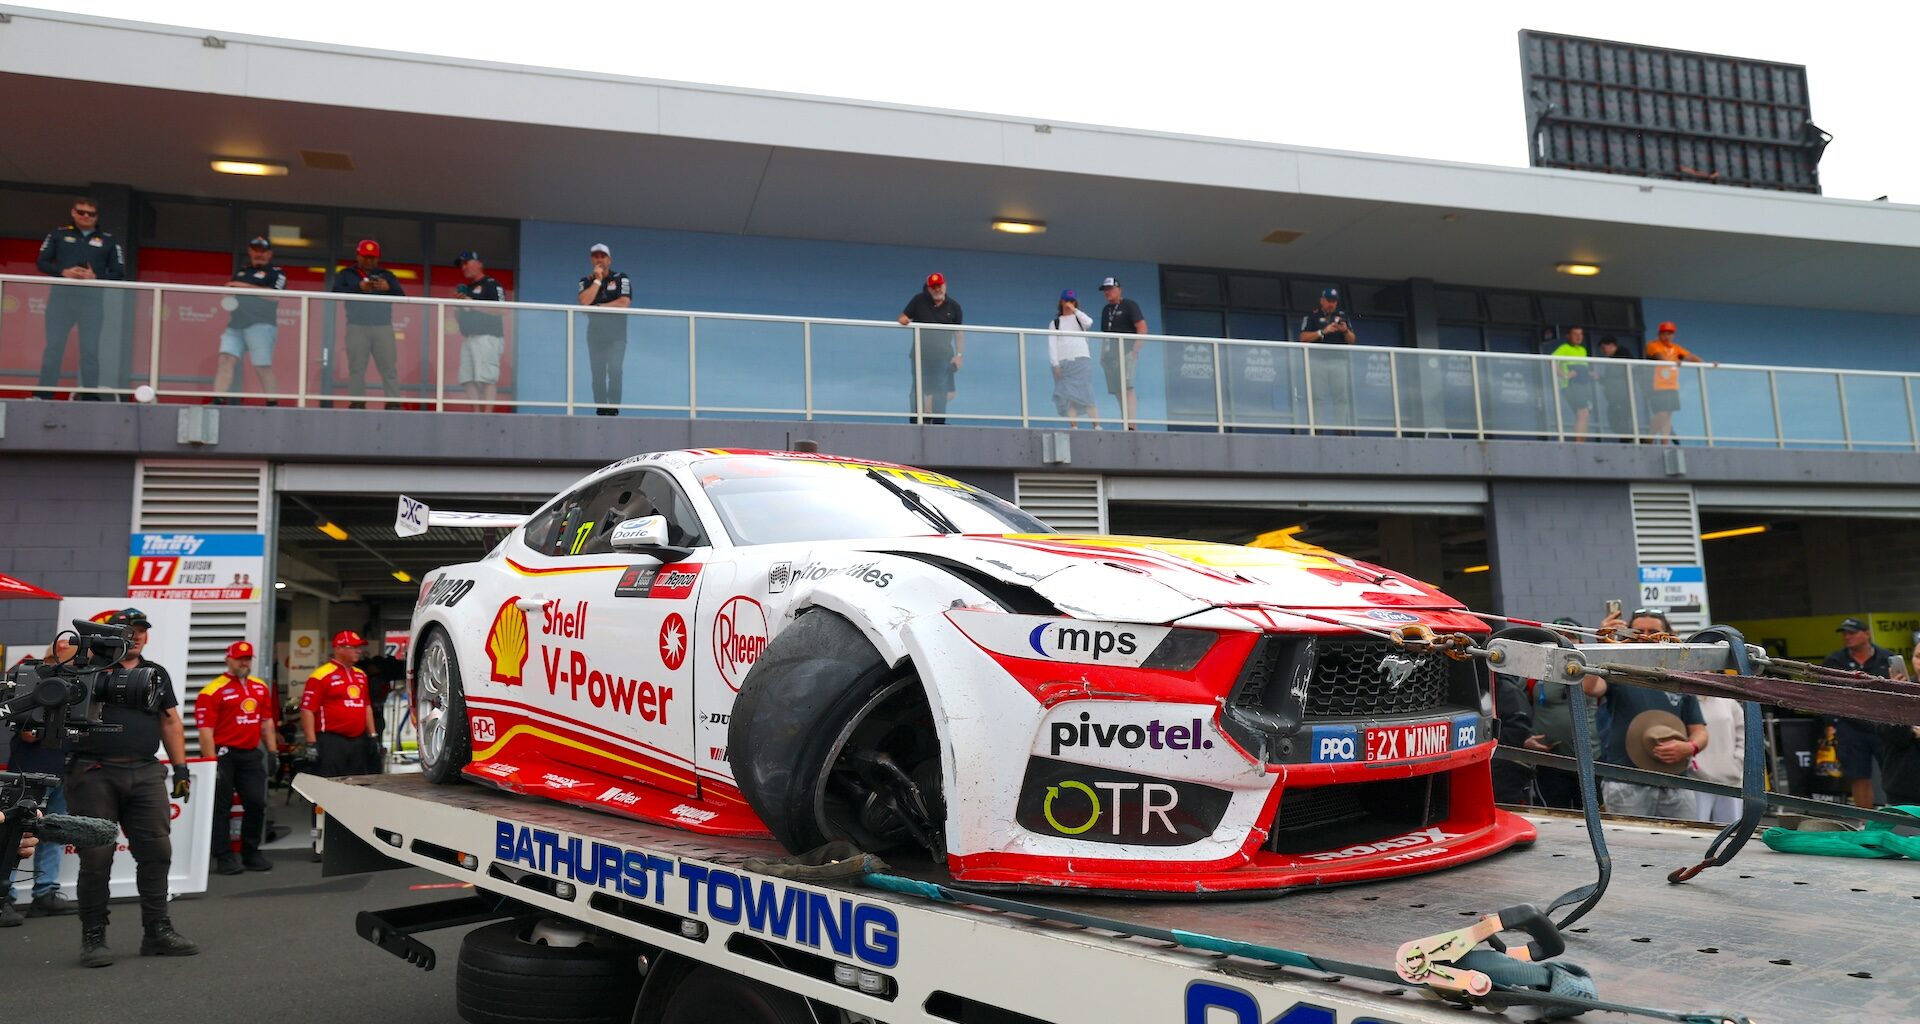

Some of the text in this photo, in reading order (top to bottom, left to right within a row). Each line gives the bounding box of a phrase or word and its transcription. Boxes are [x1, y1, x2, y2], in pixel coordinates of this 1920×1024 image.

[401, 498, 423, 525] DXC
[142, 535, 205, 554] Thrifty
[570, 522, 595, 554] 17
[614, 530, 648, 539] Doric
[141, 560, 173, 582] 17
[664, 571, 696, 588] Repco
[221, 590, 242, 599] TEAM
[1644, 586, 1659, 600] 20
[542, 598, 588, 640] Shell
[719, 600, 767, 675] Rheem
[1057, 627, 1137, 660] mps
[542, 644, 673, 726] V-Power
[473, 718, 495, 739] PPG
[1050, 711, 1213, 756] pivotel.
[1457, 726, 1477, 748] PPQ
[1320, 737, 1355, 760] PPQ
[1377, 725, 1448, 760] 2X WINNR
[1300, 827, 1465, 861] ROADX
[1384, 847, 1449, 862] TYRES
[496, 820, 899, 968] BATHURST TOWING
